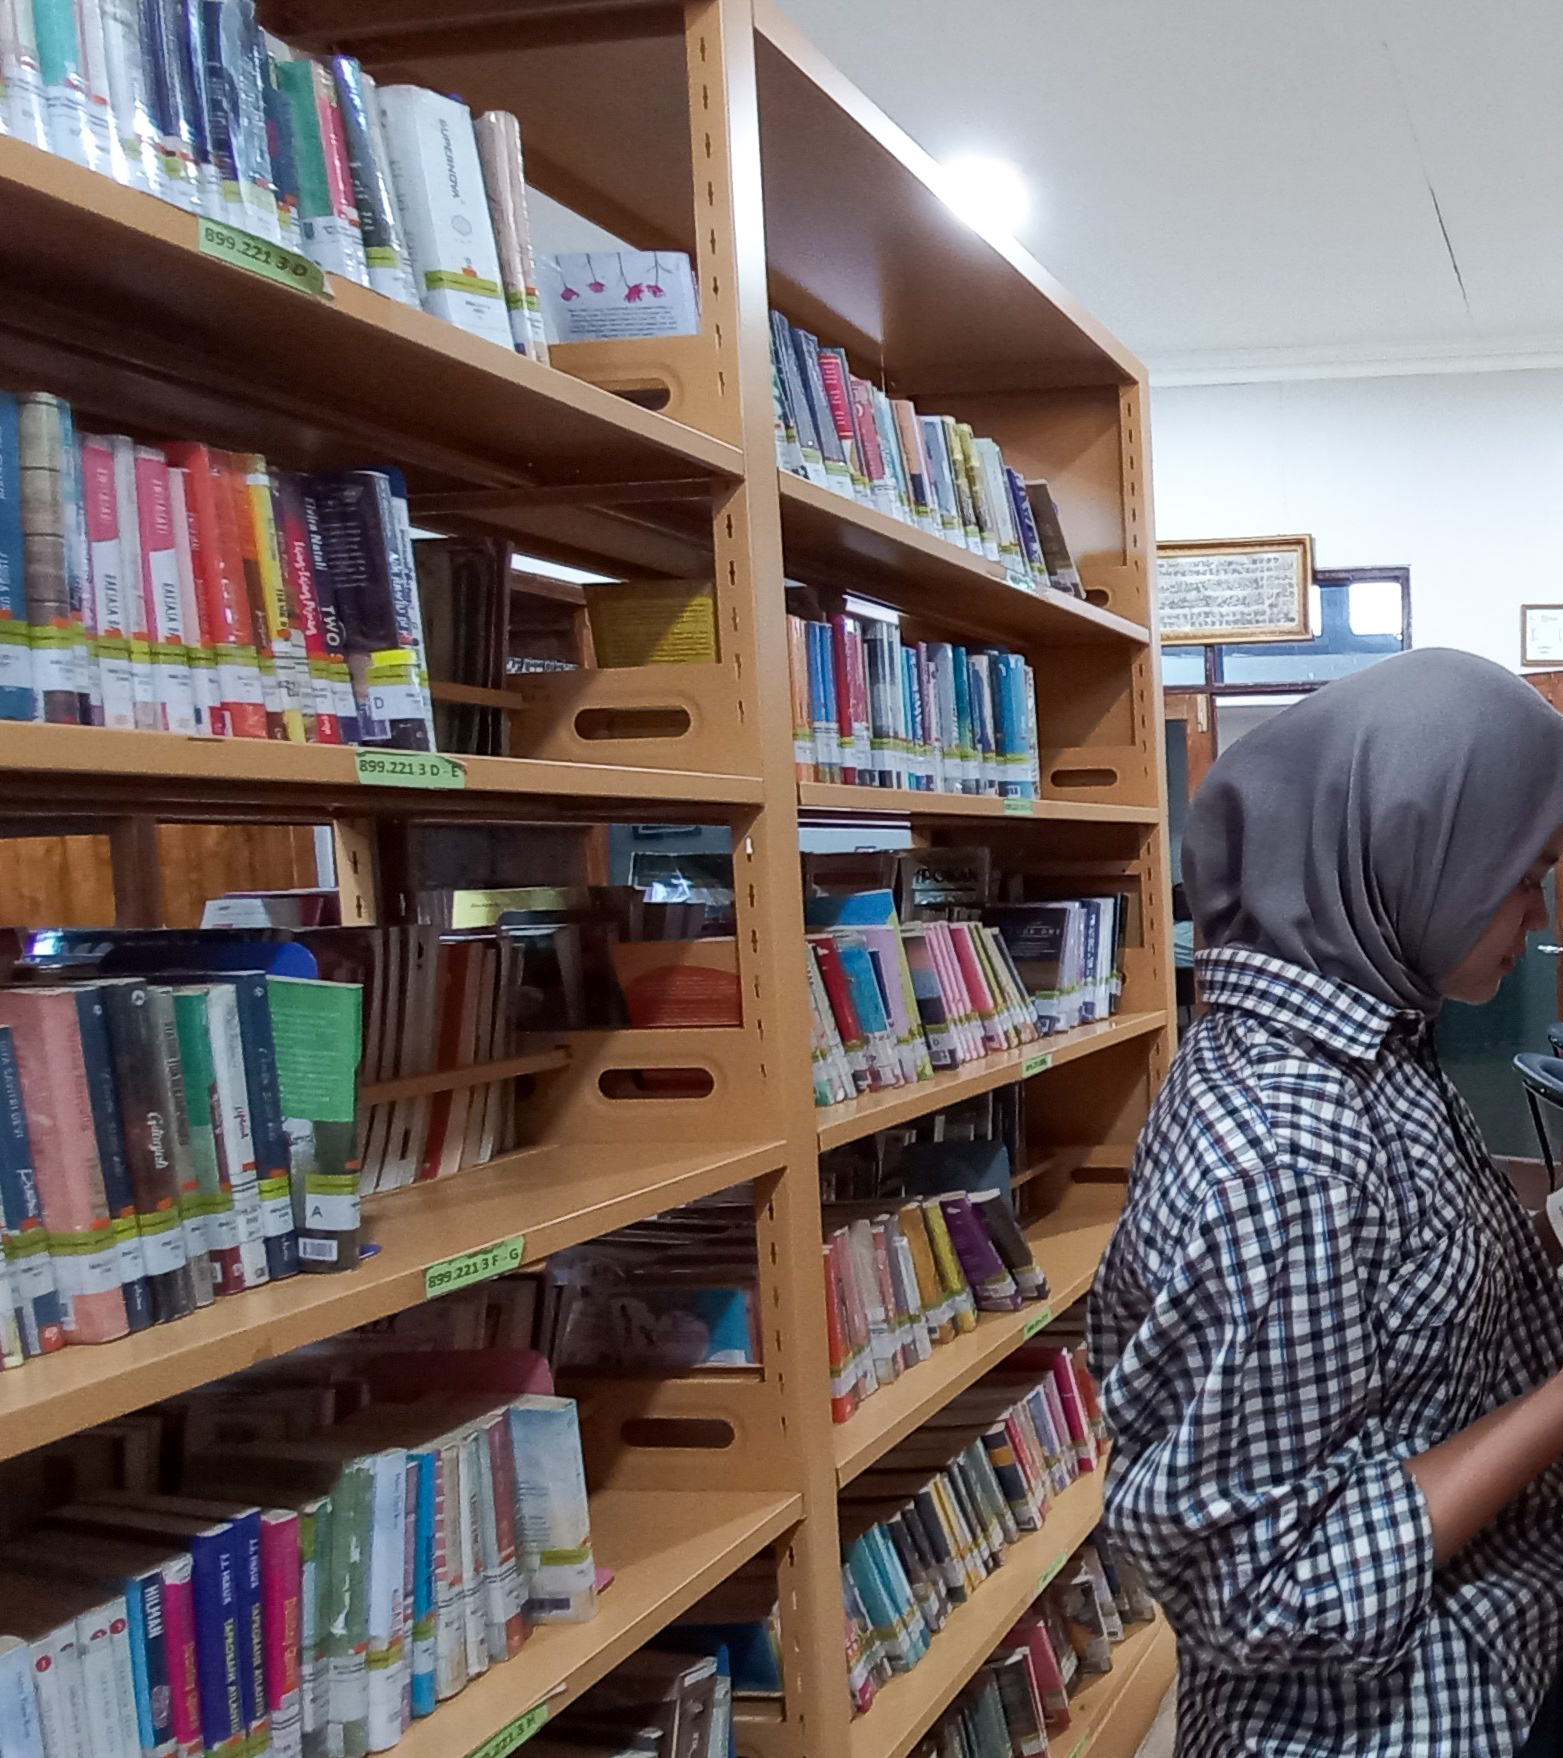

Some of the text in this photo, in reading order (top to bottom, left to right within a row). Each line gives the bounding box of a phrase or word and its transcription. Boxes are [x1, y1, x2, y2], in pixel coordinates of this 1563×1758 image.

[321, 605, 340, 647] TWO
[358, 759, 414, 776] 899.221
[417, 762, 428, 776] 3
[430, 763, 441, 778] D
[311, 1205, 323, 1219] A
[427, 1259, 478, 1290] 899.221
[144, 1583, 163, 1639] HILMAN
